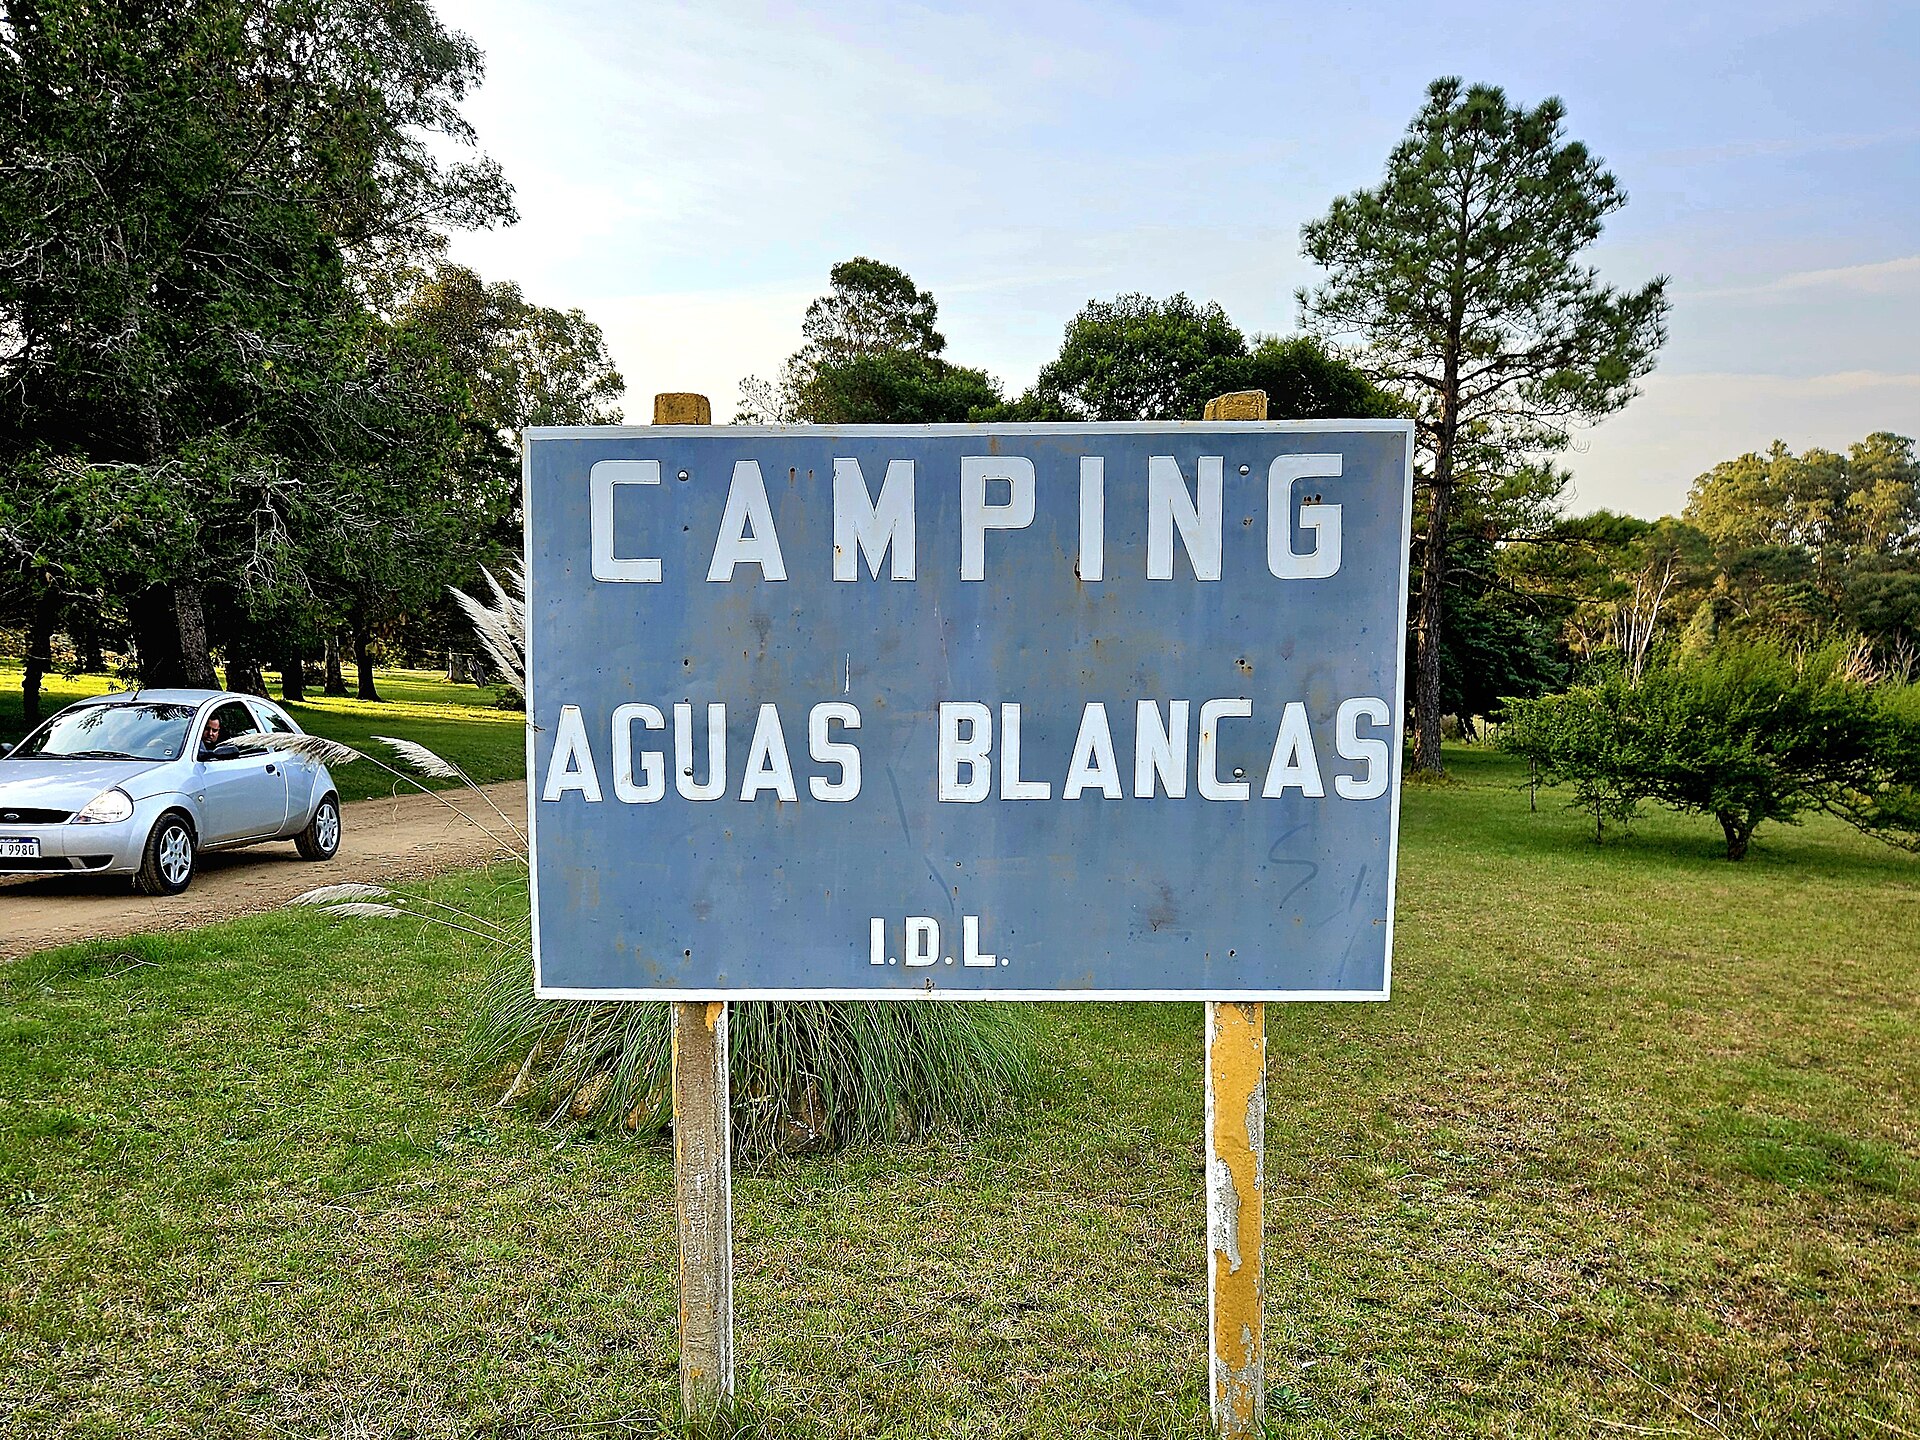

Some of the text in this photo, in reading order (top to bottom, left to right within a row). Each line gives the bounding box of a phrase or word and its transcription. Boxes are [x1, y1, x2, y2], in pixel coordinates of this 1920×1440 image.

[589, 453, 1343, 582] CAMPING
[541, 697, 1391, 803] AGUAS BLANCAS
[8, 844, 35, 856] 9980
[869, 914, 1010, 968] I.D.L.
